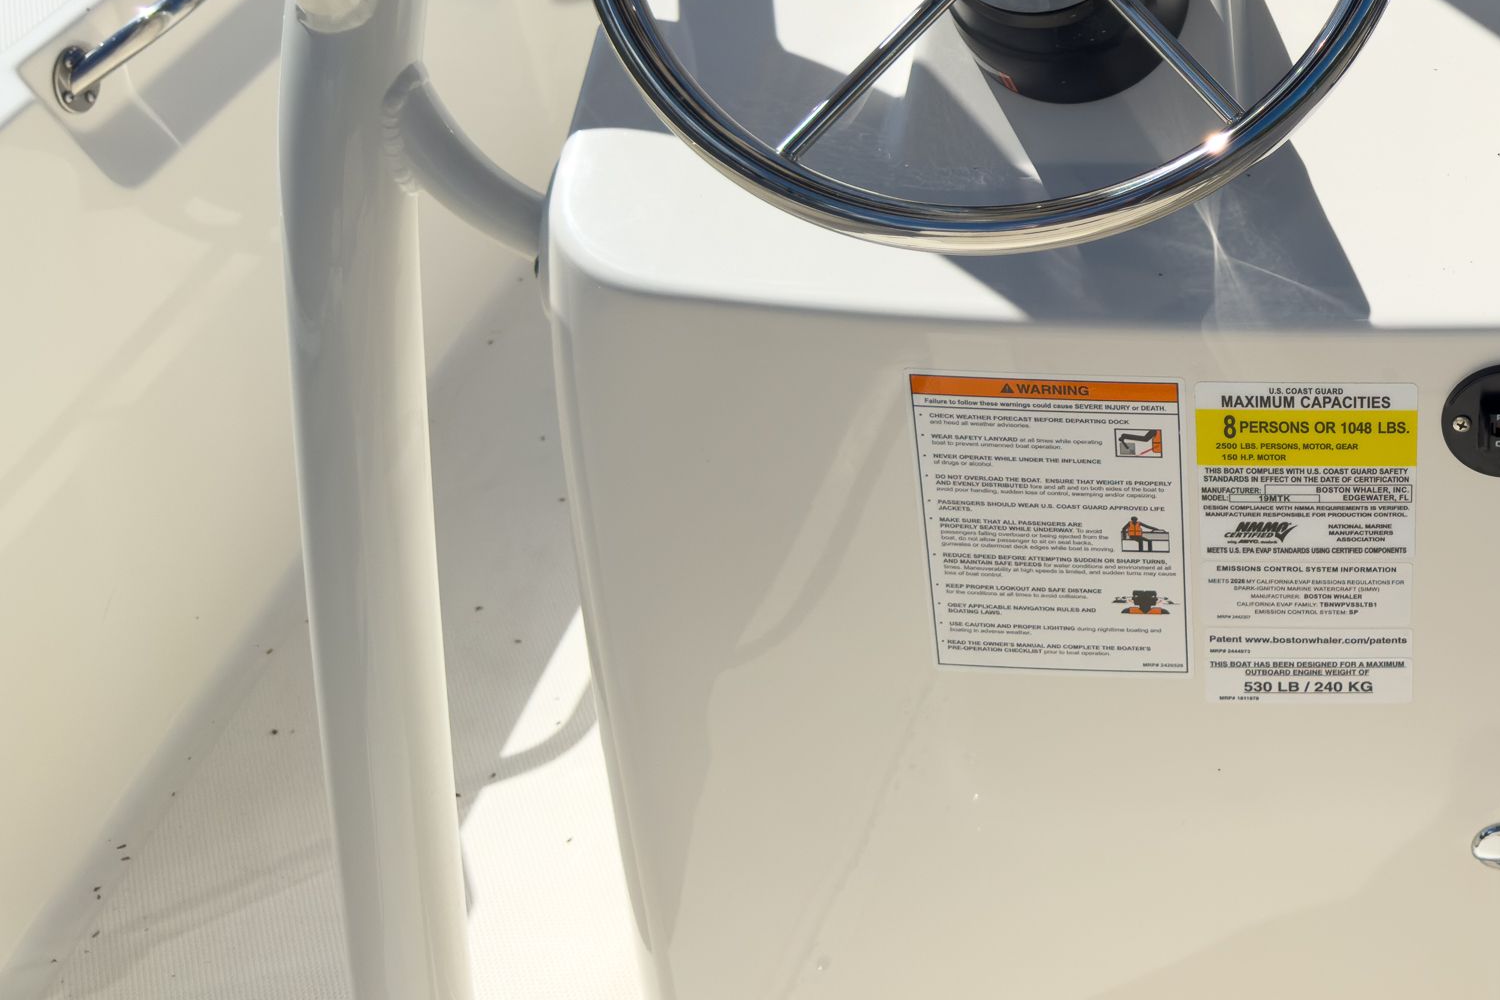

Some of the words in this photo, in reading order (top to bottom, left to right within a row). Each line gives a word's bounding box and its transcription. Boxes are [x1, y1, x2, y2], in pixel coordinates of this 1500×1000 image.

[1015, 383, 1089, 396] WARNING
[1221, 395, 1295, 408] MAXIMUM
[1300, 395, 1391, 408] CAPACITIES
[1223, 414, 1236, 439] 8
[1239, 420, 1309, 433] PERSONS
[1313, 420, 1336, 434] OR
[1340, 421, 1372, 434] 1048
[1377, 421, 1410, 434] LBS.
[1200, 486, 1262, 495] MANUFACTURER:
[1258, 494, 1290, 503] 19MTK
[1342, 494, 1397, 502] EDGEWATER,
[1398, 494, 1409, 502] FL
[1208, 634, 1242, 642] Patent
[1244, 681, 1272, 693] 530
[1277, 681, 1299, 693] LB
[1313, 681, 1343, 693] 240
[1348, 680, 1373, 693] KG
